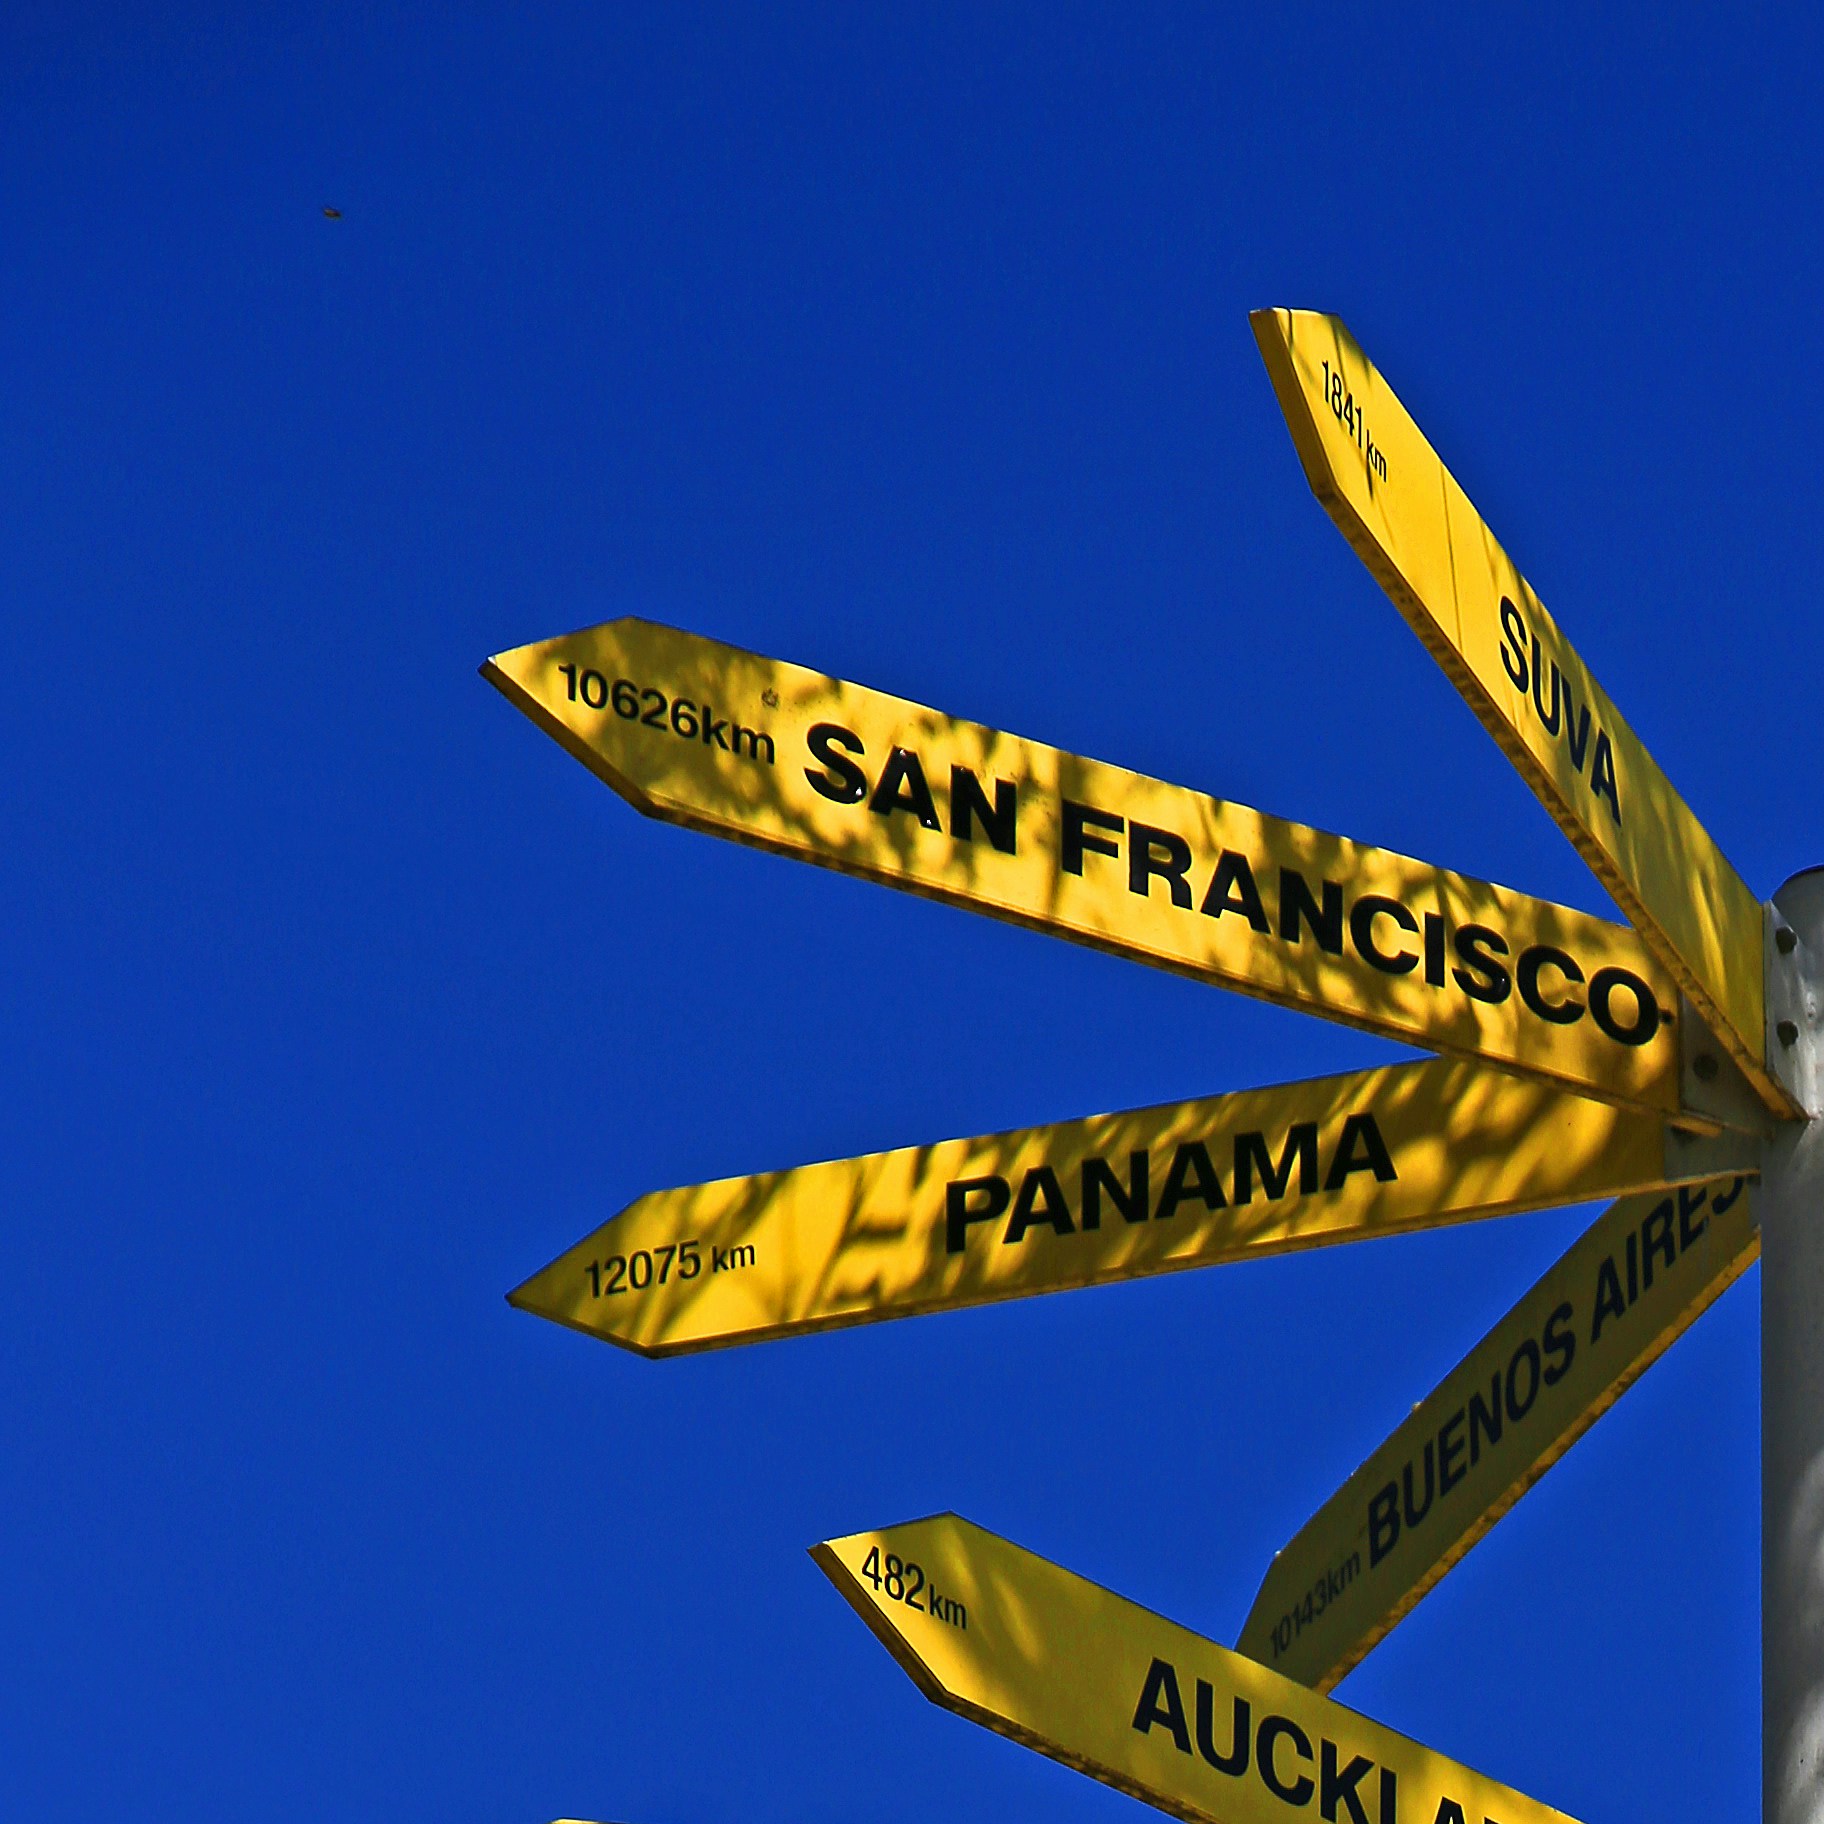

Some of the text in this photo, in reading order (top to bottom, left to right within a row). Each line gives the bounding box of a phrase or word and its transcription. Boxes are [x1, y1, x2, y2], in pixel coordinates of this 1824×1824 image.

[1500, 595, 1621, 827] SUVA
[558, 662, 1660, 1047] 10626km SAN FRANCISCO
[584, 1112, 1398, 1298] 12075 km PANAMA
[1367, 1301, 1577, 1570] BUENOS
